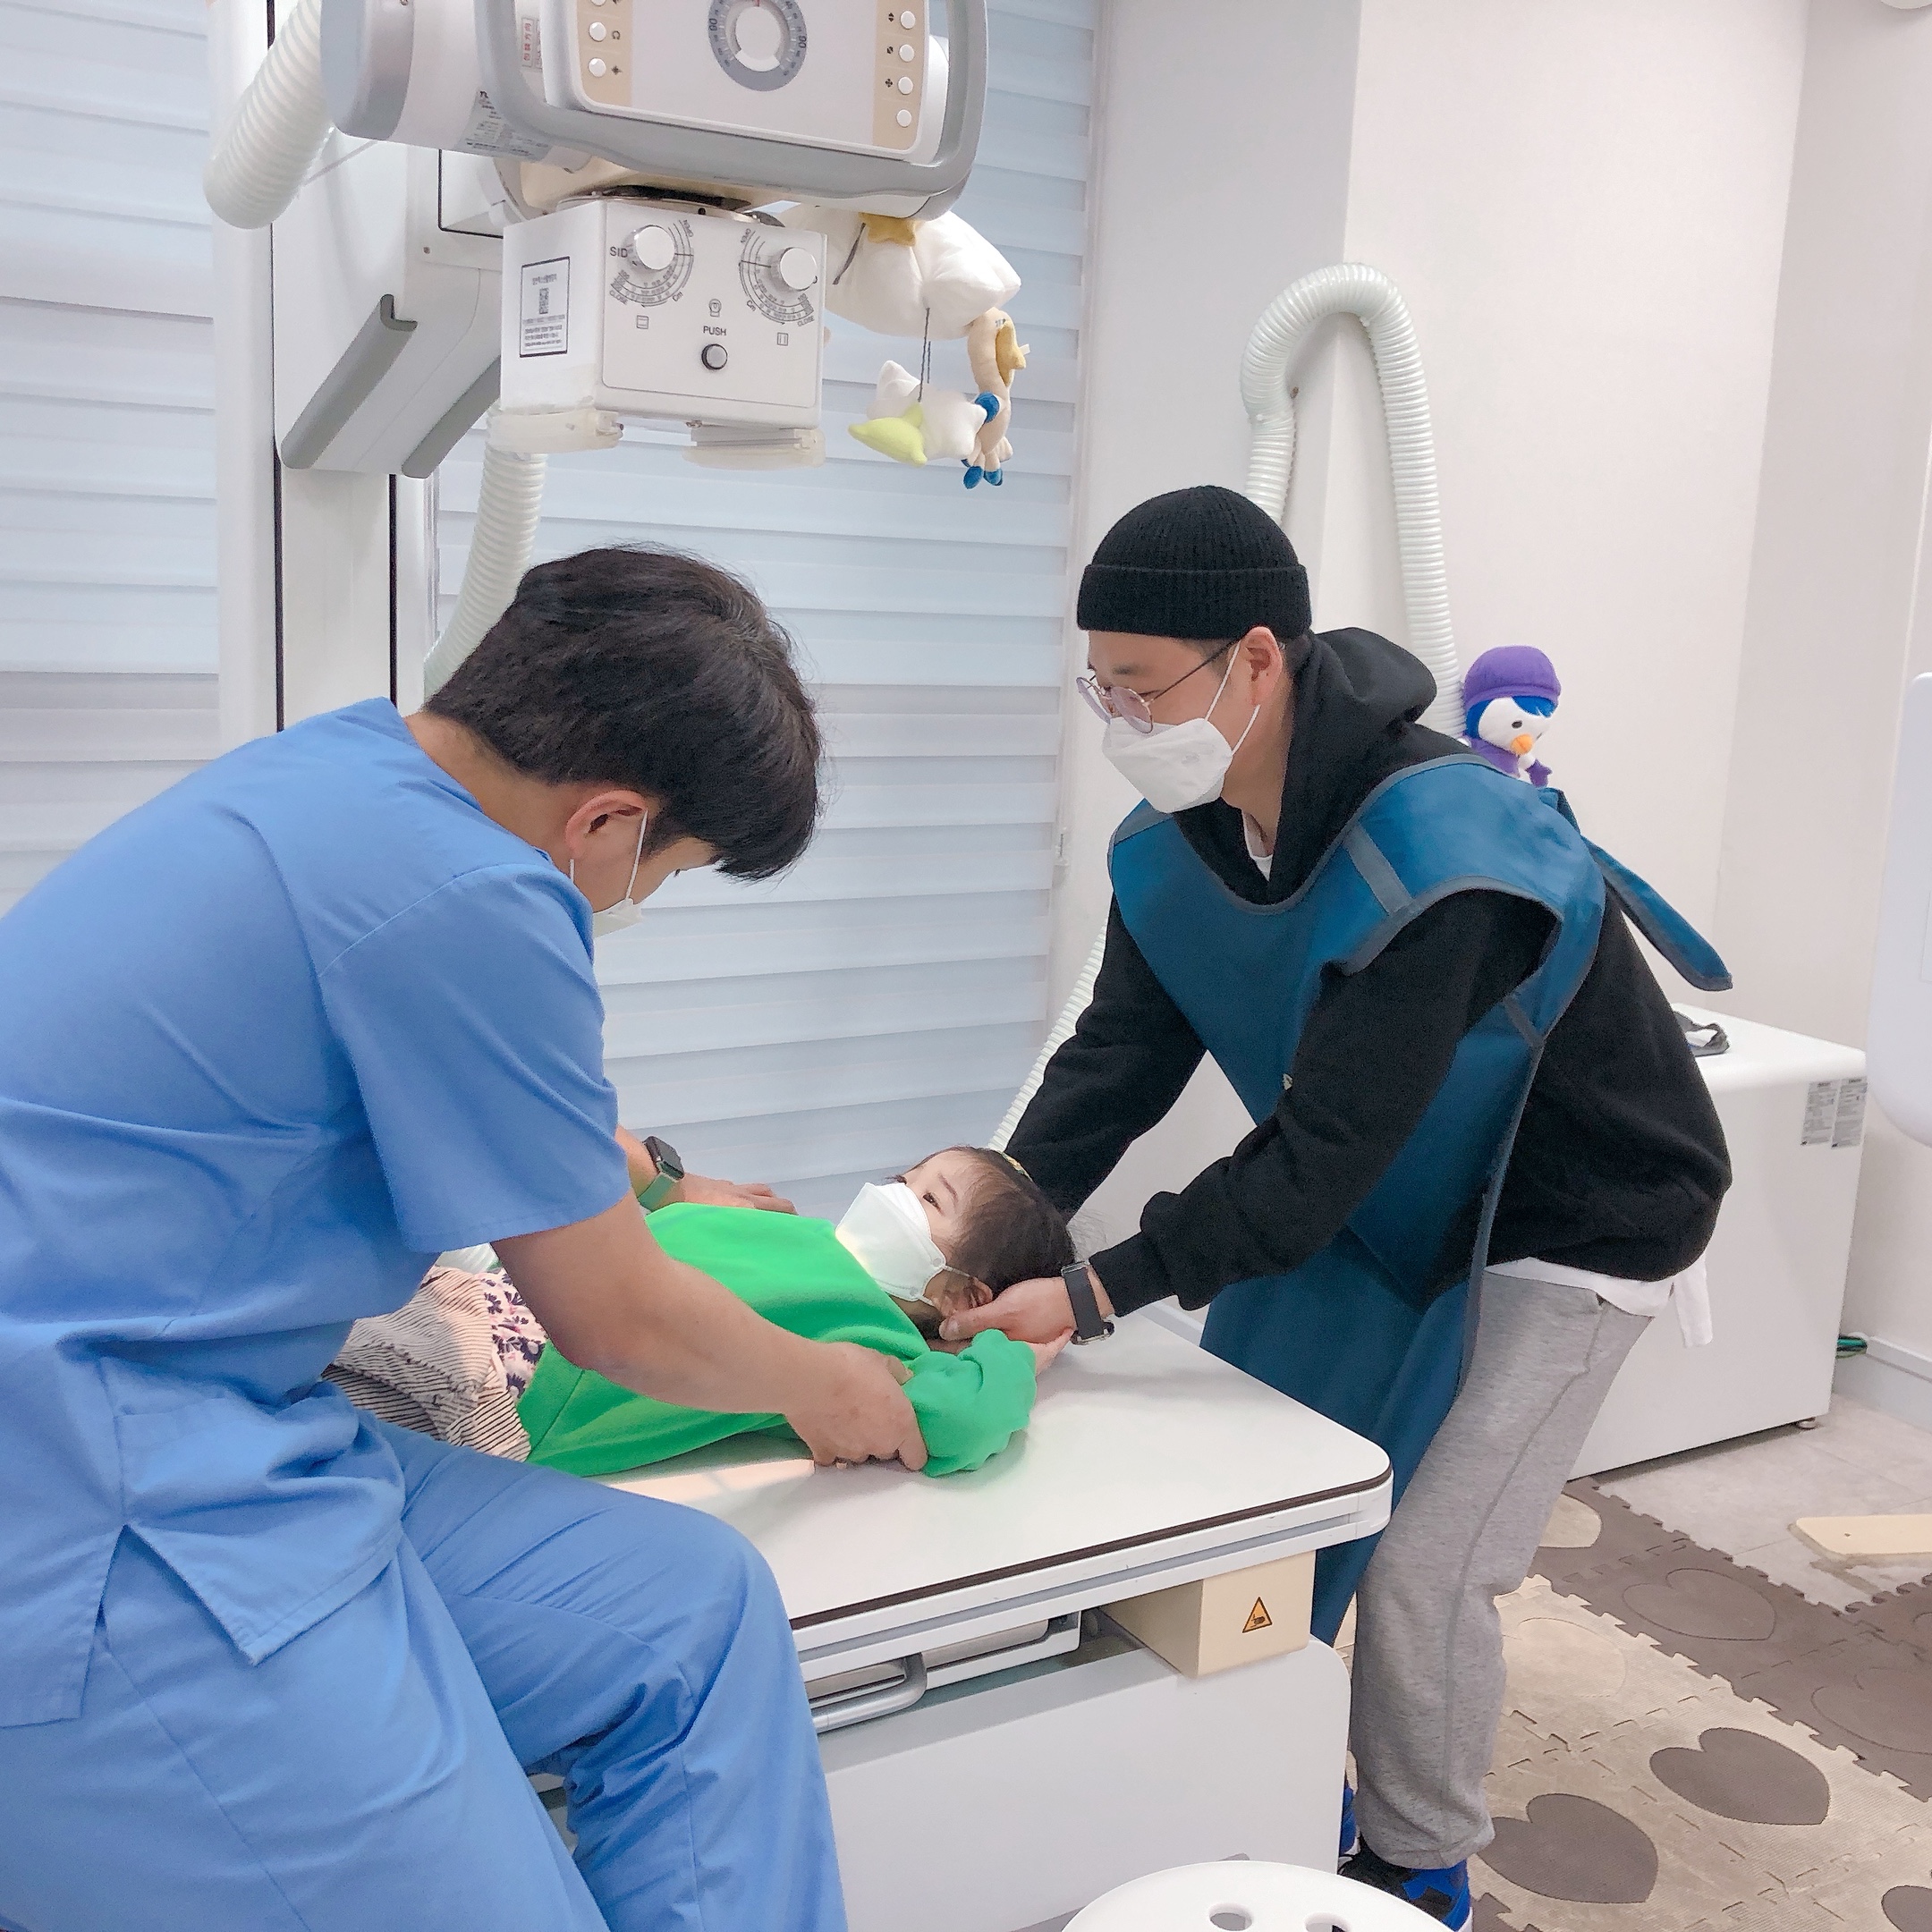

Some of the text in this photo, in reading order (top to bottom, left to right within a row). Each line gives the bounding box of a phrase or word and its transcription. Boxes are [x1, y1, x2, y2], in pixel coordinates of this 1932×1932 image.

[798, 35, 807, 48] 90
[609, 246, 629, 258] SID
[609, 290, 628, 305] CLOSE
[797, 316, 816, 327] CLOSE
[702, 325, 727, 336] PUSH
